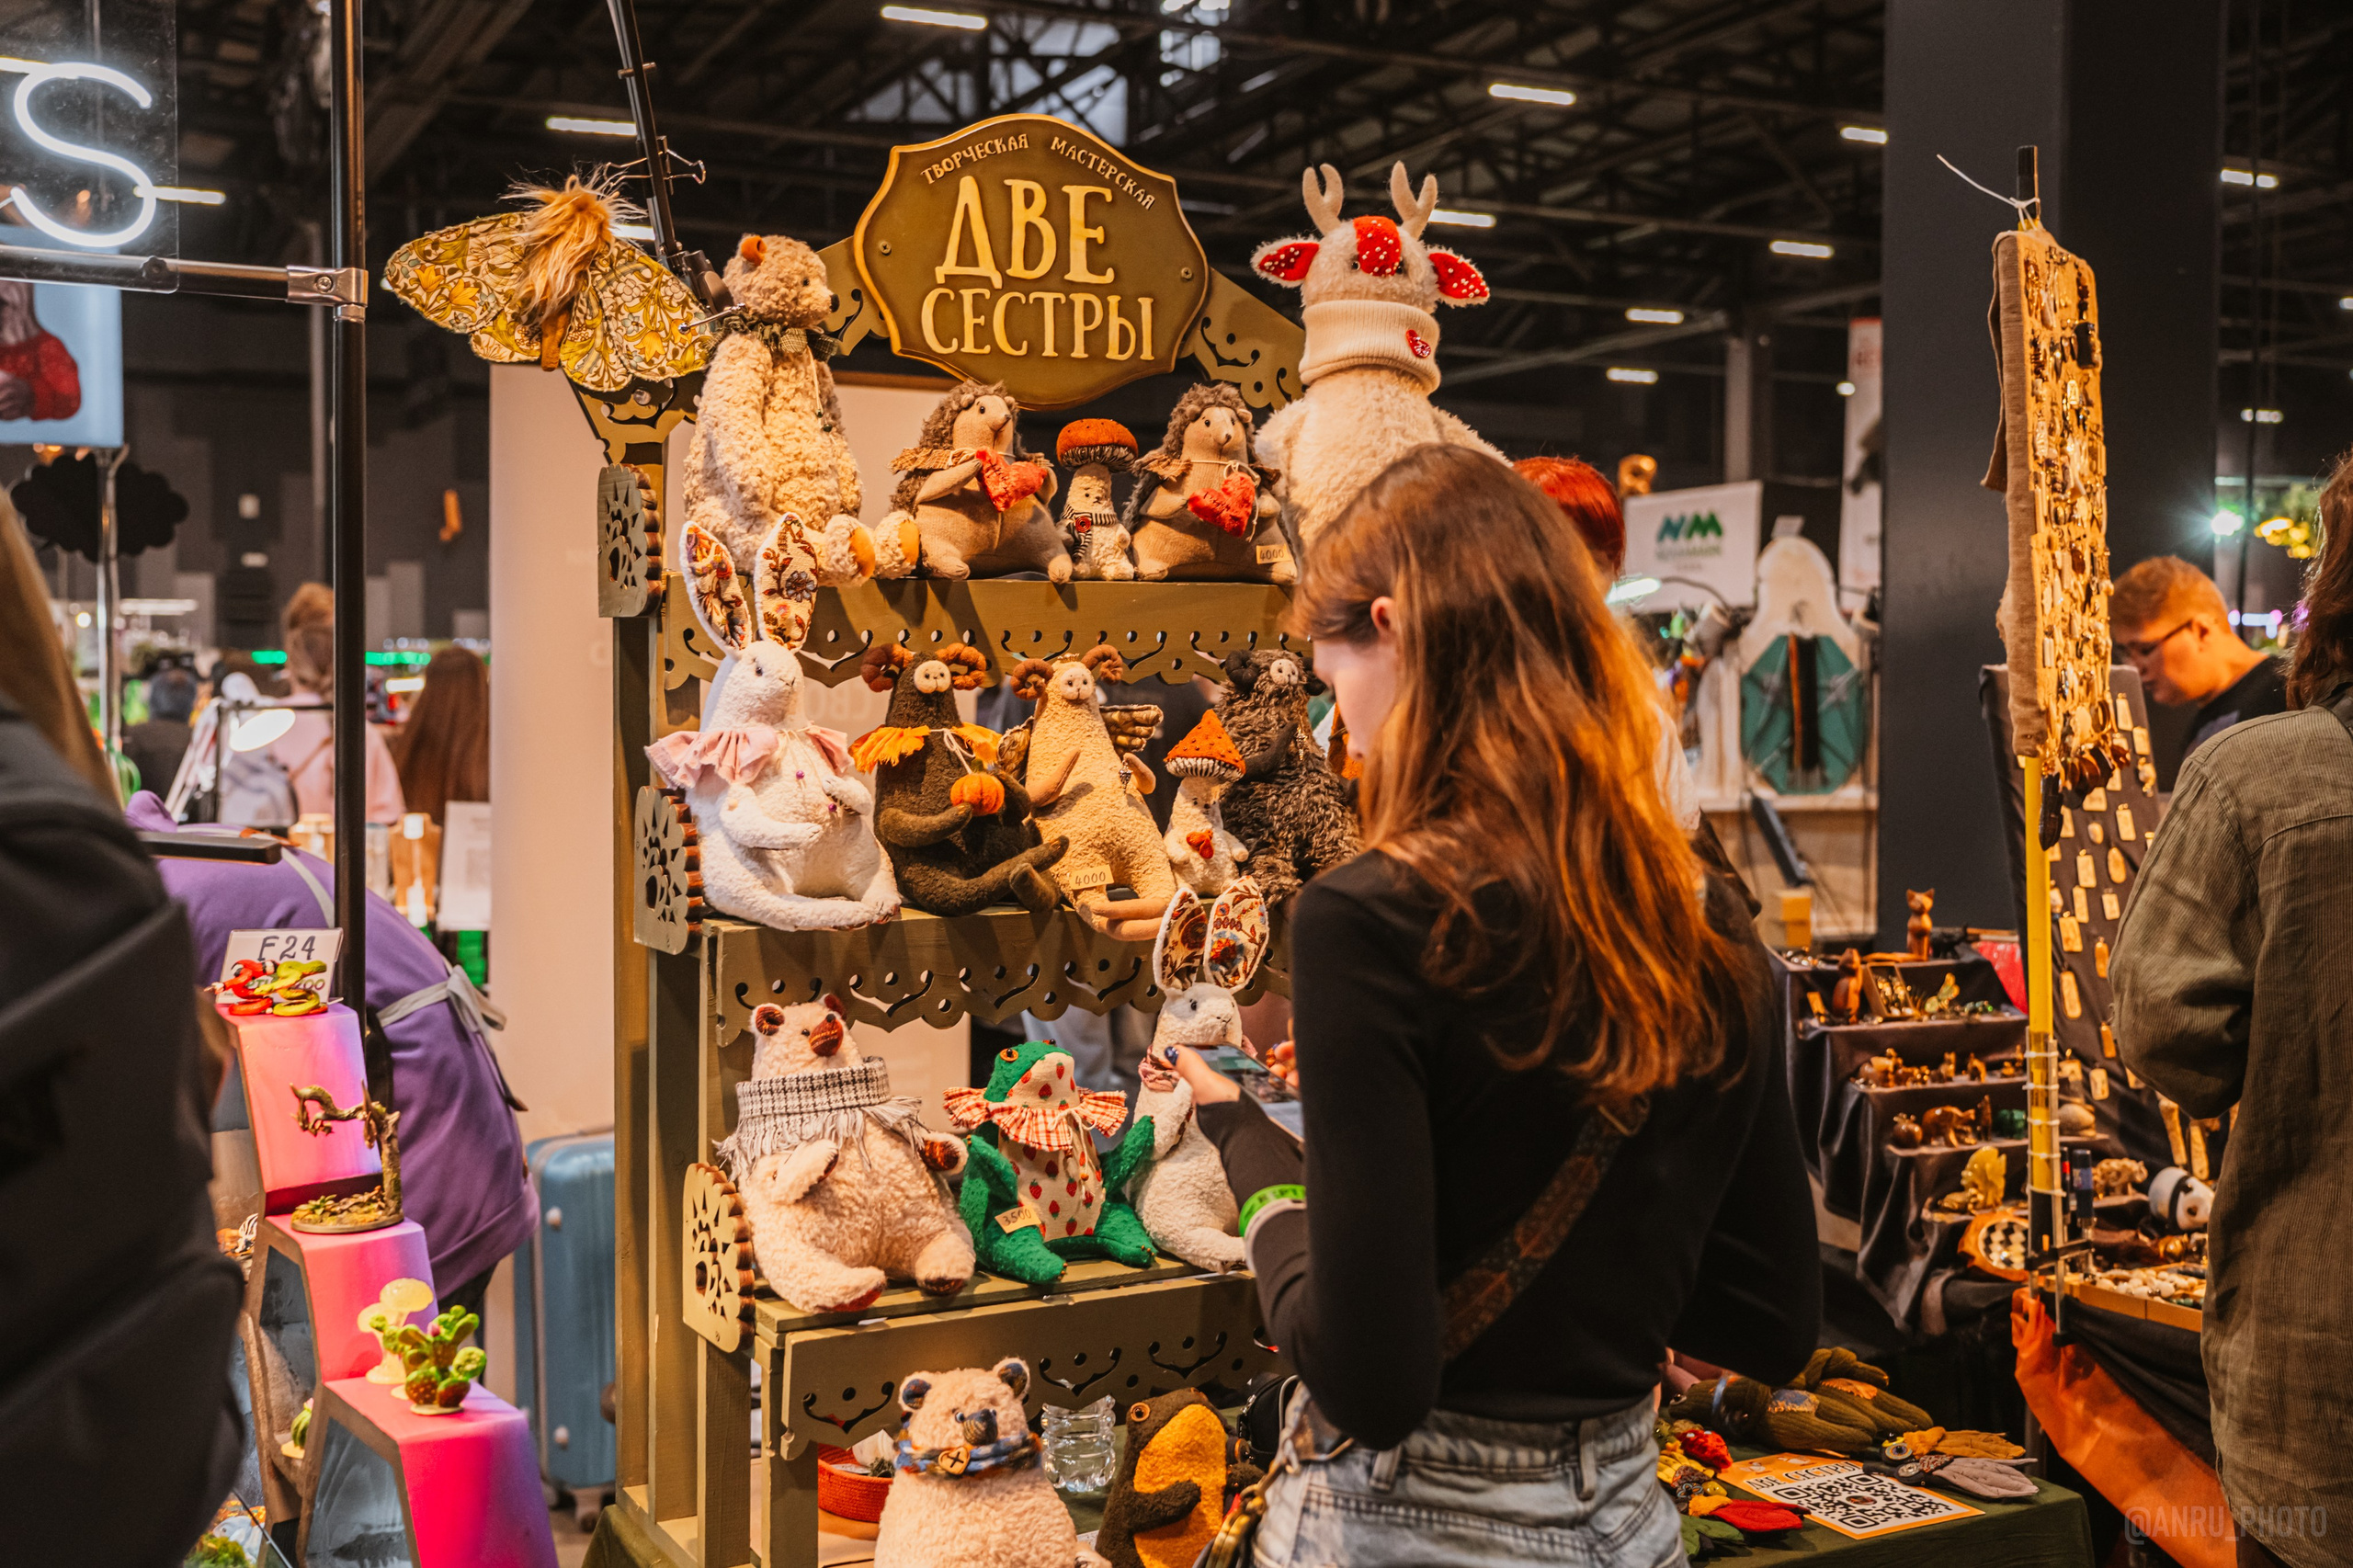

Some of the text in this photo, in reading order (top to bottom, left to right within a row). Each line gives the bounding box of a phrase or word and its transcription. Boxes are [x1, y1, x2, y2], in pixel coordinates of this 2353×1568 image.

[920, 133, 1155, 210] ТВОРЧЕСКАЯ МАСТЕРСКАЯ
[935, 175, 1114, 289] ДВЕ
[921, 287, 1155, 360] СЕСТРЫ
[1260, 549, 1284, 561] 4000
[1075, 871, 1106, 886] 4000
[1003, 1209, 1031, 1226] 3500
[1784, 1461, 1861, 1482] СЕСТРЫ
